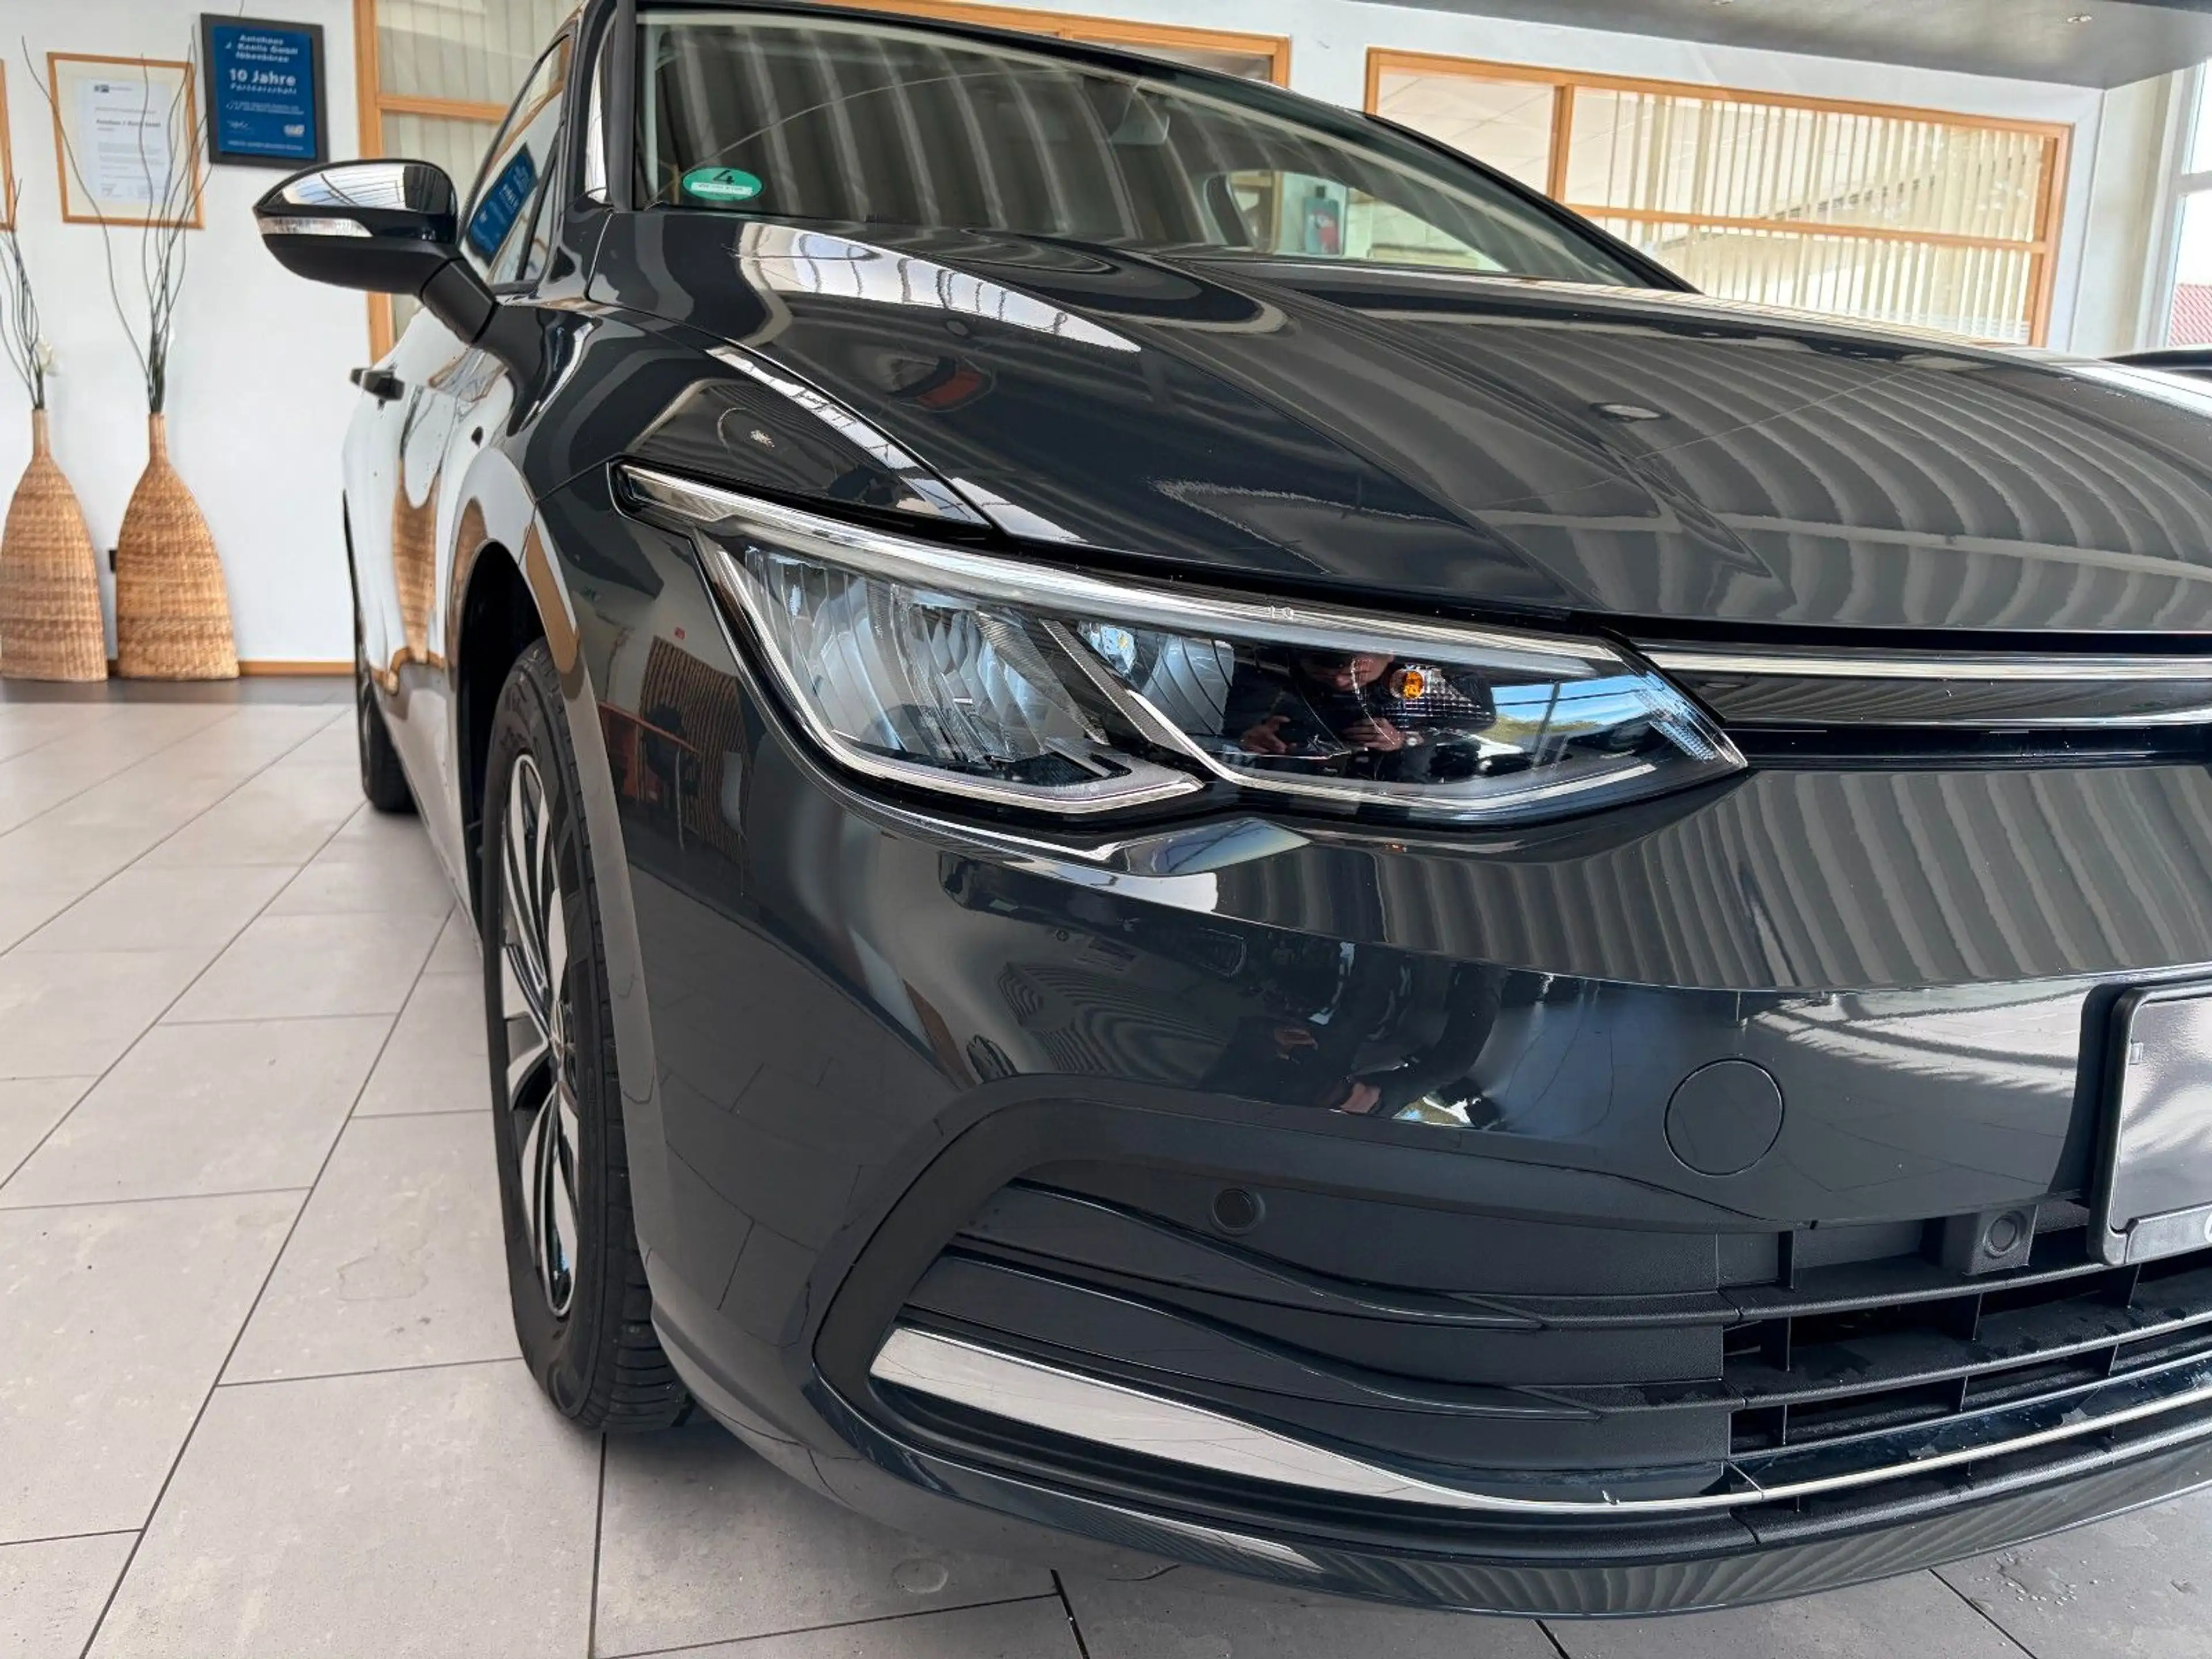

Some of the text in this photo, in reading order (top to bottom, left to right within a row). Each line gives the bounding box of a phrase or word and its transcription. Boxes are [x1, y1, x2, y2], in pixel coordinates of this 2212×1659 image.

[229, 67, 296, 86] 10 Jahre
[713, 169, 734, 184] 4
